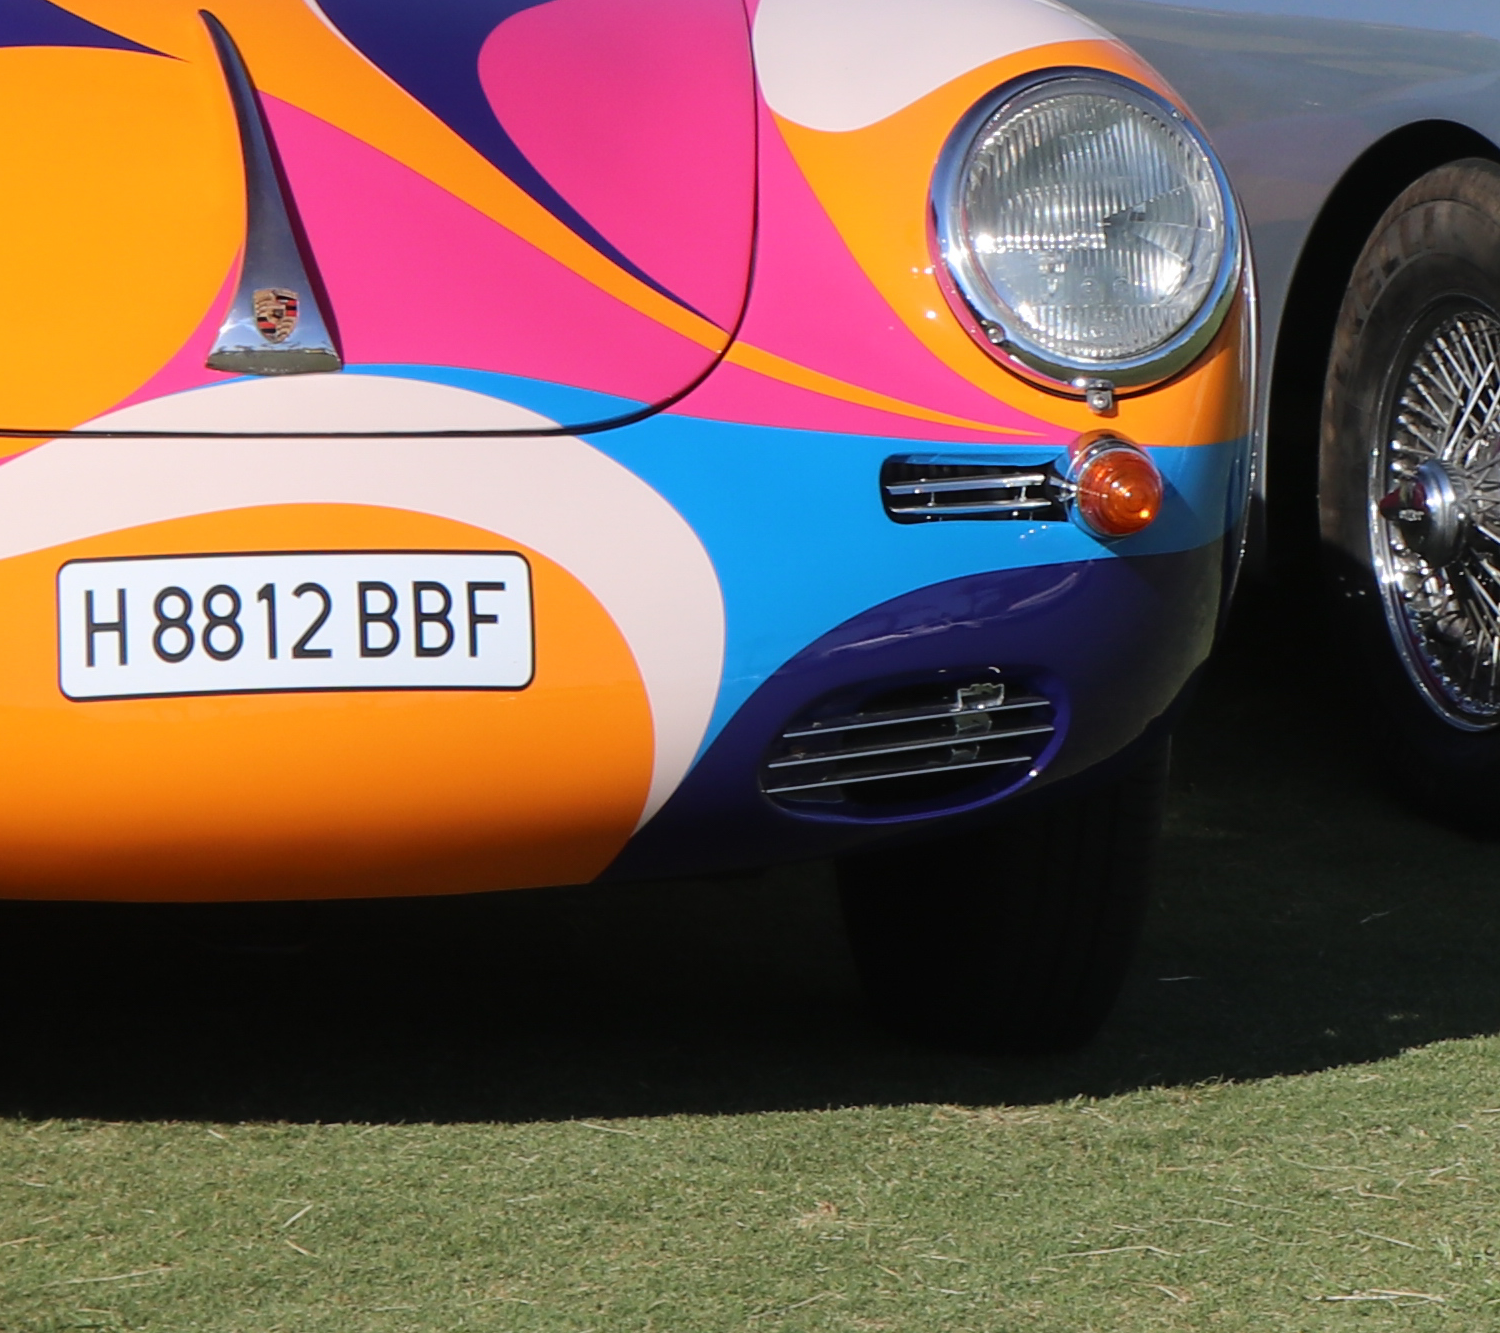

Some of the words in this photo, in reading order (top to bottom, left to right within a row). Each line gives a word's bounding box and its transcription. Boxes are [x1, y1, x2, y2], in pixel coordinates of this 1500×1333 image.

[84, 588, 128, 667] H
[152, 582, 333, 664] 8812
[356, 580, 507, 658] BBF
